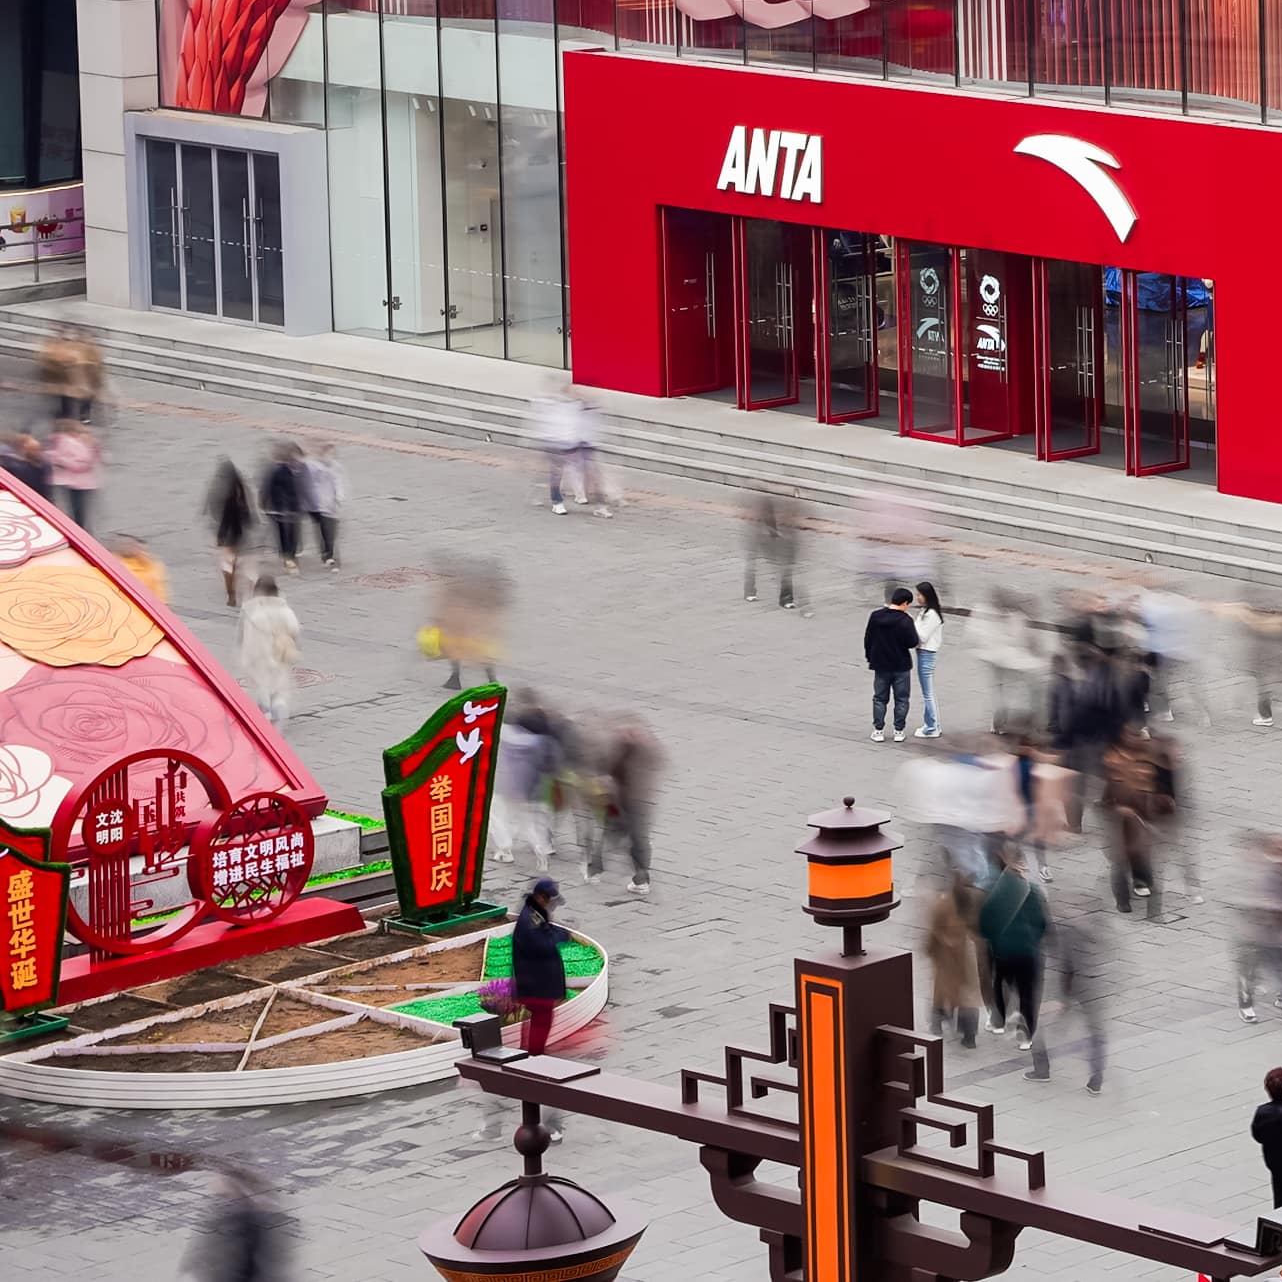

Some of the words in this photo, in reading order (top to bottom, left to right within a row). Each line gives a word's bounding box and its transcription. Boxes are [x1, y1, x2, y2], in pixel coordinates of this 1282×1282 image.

[716, 125, 823, 204] ANTA
[212, 832, 304, 869] 培育文明风尚
[213, 850, 305, 887] 增进民生福祉
[429, 774, 453, 892] 举国同庆
[7, 869, 38, 991] 盛世华诞
